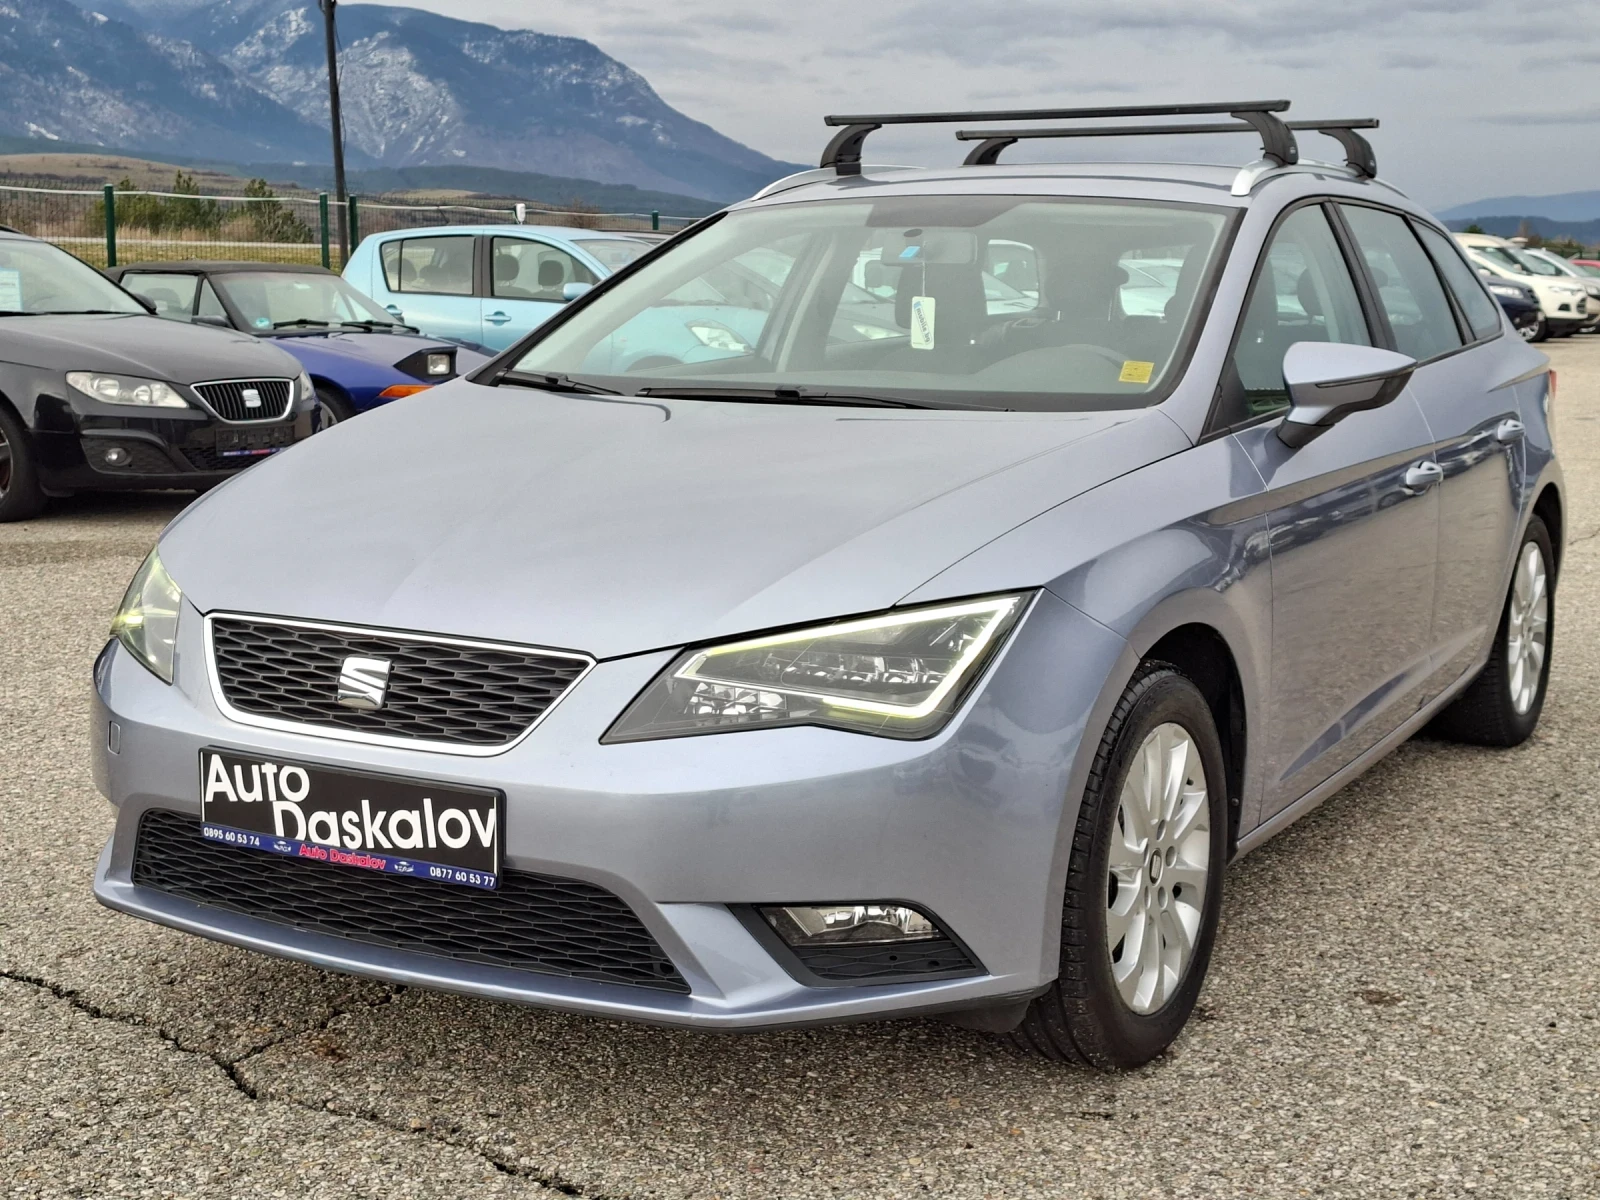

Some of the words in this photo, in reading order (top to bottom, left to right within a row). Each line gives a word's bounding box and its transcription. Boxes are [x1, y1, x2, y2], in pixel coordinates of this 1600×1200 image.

[205, 753, 310, 802] Auto
[272, 798, 495, 849] Daskalov
[203, 827, 223, 839] 0895
[225, 831, 236, 842] 60
[237, 834, 248, 844] 53
[249, 836, 260, 846] 74
[299, 844, 328, 860] Auto
[329, 848, 387, 870] Daskalov
[429, 866, 453, 879] 0877
[455, 871, 467, 882] 60
[469, 873, 481, 884] 53
[483, 876, 495, 887] 77
